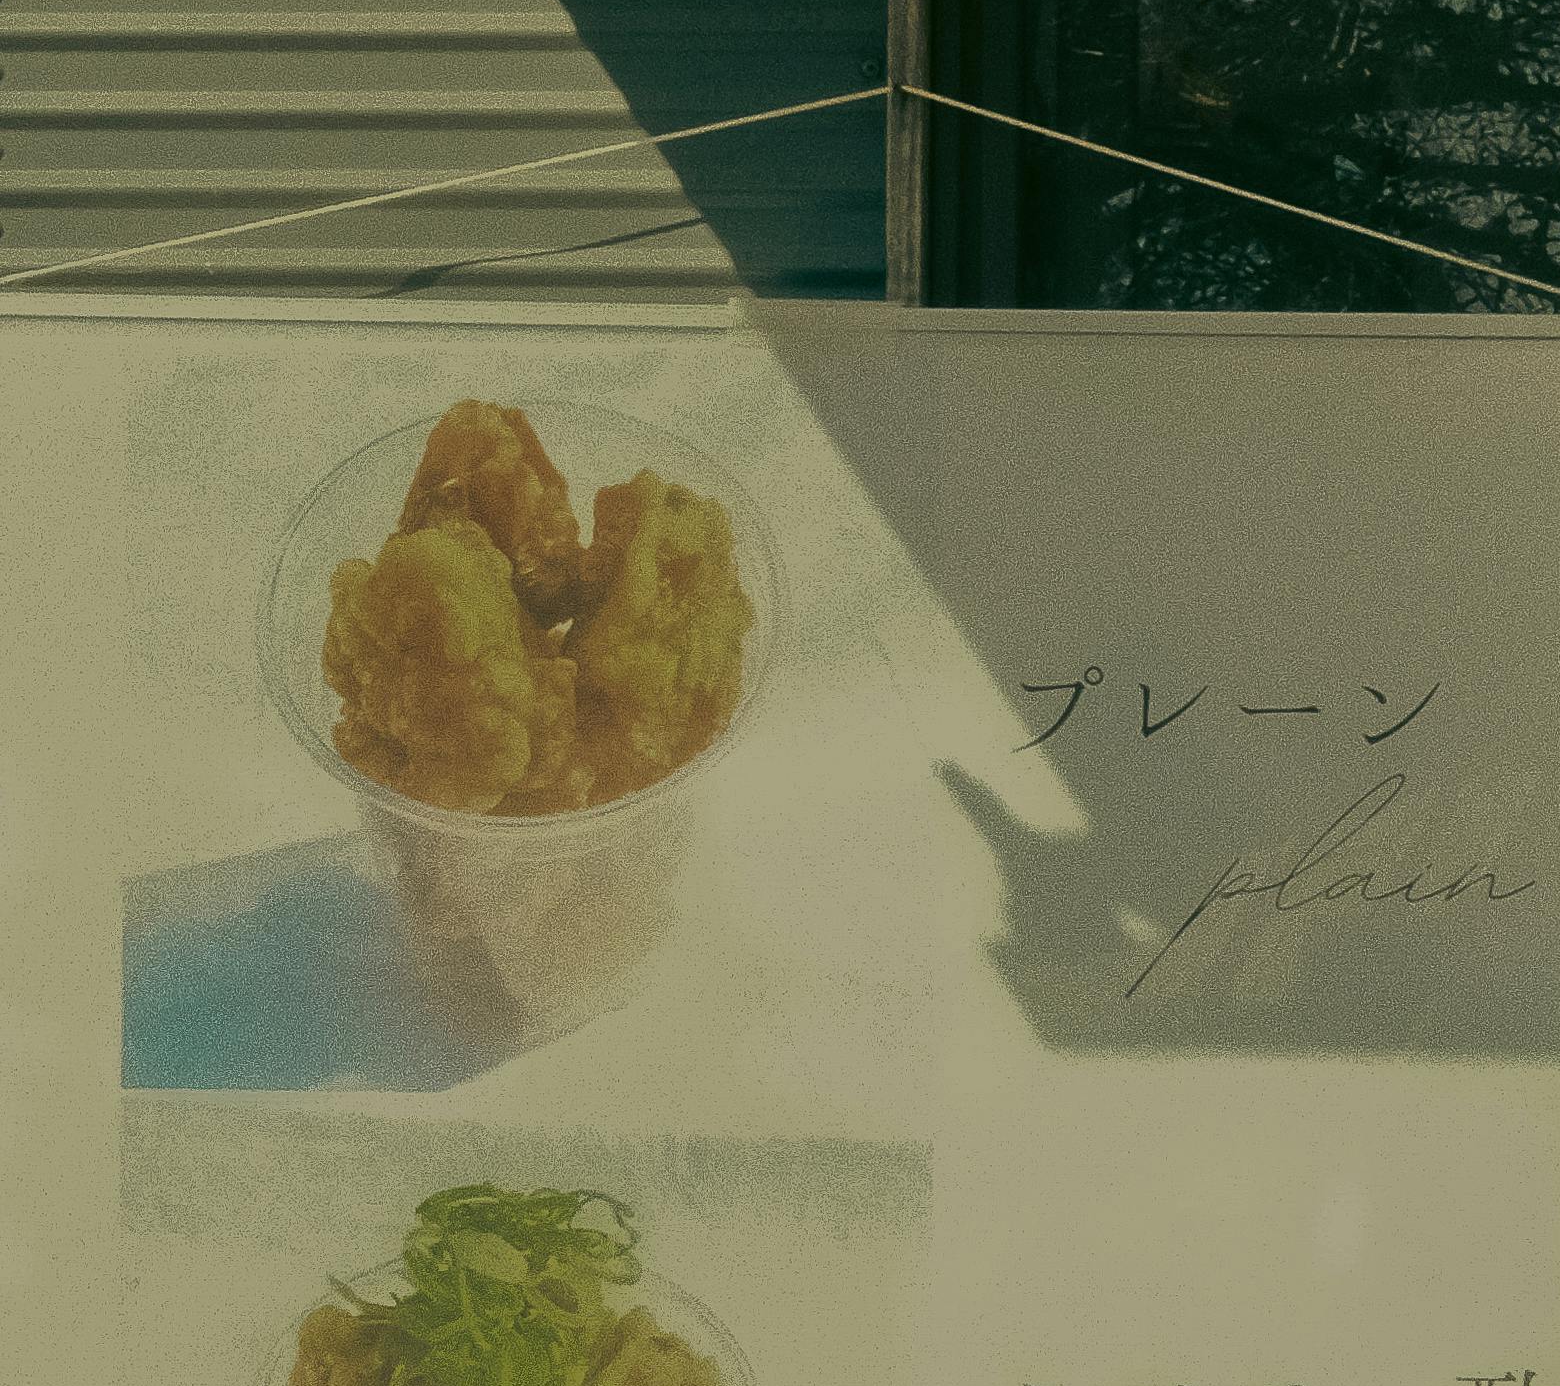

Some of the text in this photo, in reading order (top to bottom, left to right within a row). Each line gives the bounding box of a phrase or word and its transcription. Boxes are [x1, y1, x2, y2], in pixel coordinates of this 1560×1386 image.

[1010, 666, 1441, 753] プレーン
[1125, 773, 1536, 999] plain
